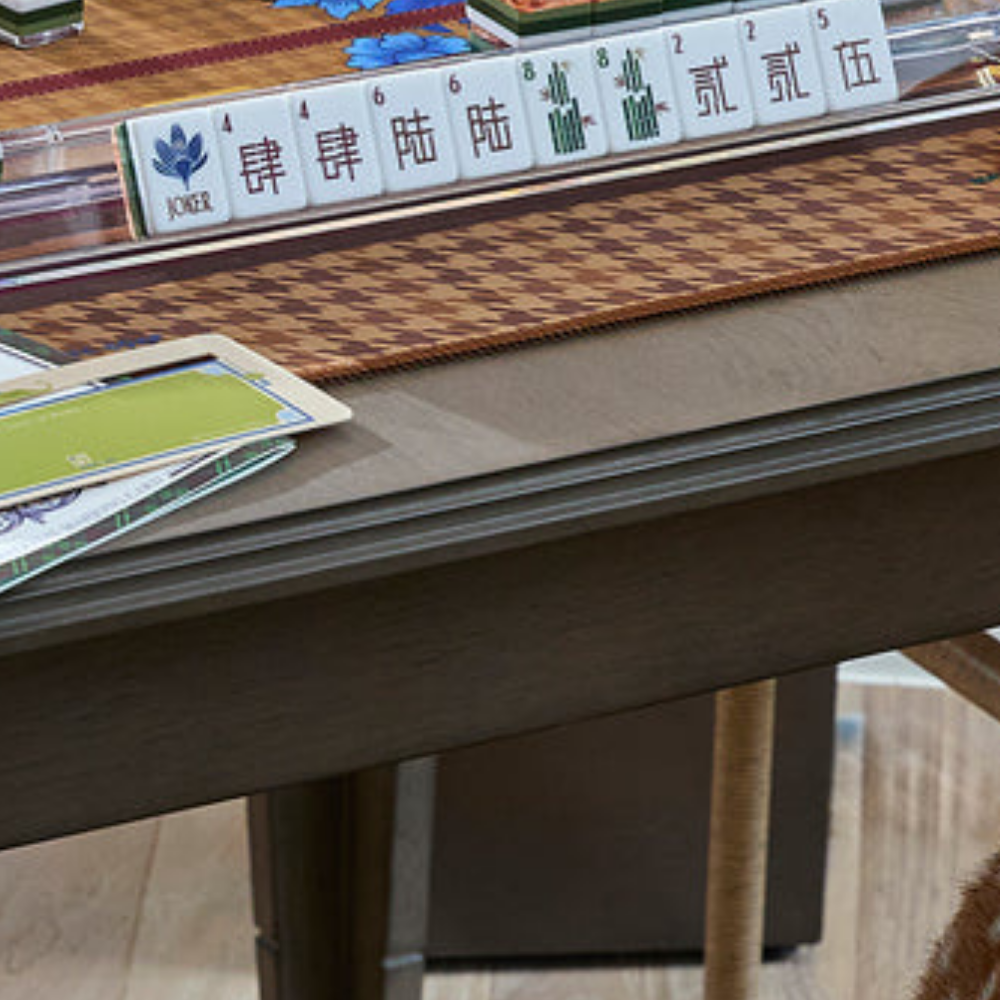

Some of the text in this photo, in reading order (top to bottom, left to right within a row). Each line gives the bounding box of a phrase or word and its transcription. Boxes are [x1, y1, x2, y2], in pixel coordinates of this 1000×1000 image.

[816, 8, 829, 30] 5
[744, 20, 756, 41] 2
[671, 33, 683, 54] 2
[596, 46, 609, 69] 8
[832, 38, 881, 92] 伍
[522, 60, 535, 81] 8
[449, 74, 462, 94] 6
[373, 86, 385, 106] 6
[299, 99, 310, 121] 4
[222, 112, 232, 133] 4
[466, 95, 513, 159] 陆
[390, 106, 438, 171] 陆
[315, 121, 363, 182] 肆
[239, 135, 287, 195] 肆
[166, 190, 214, 222] JOKER
